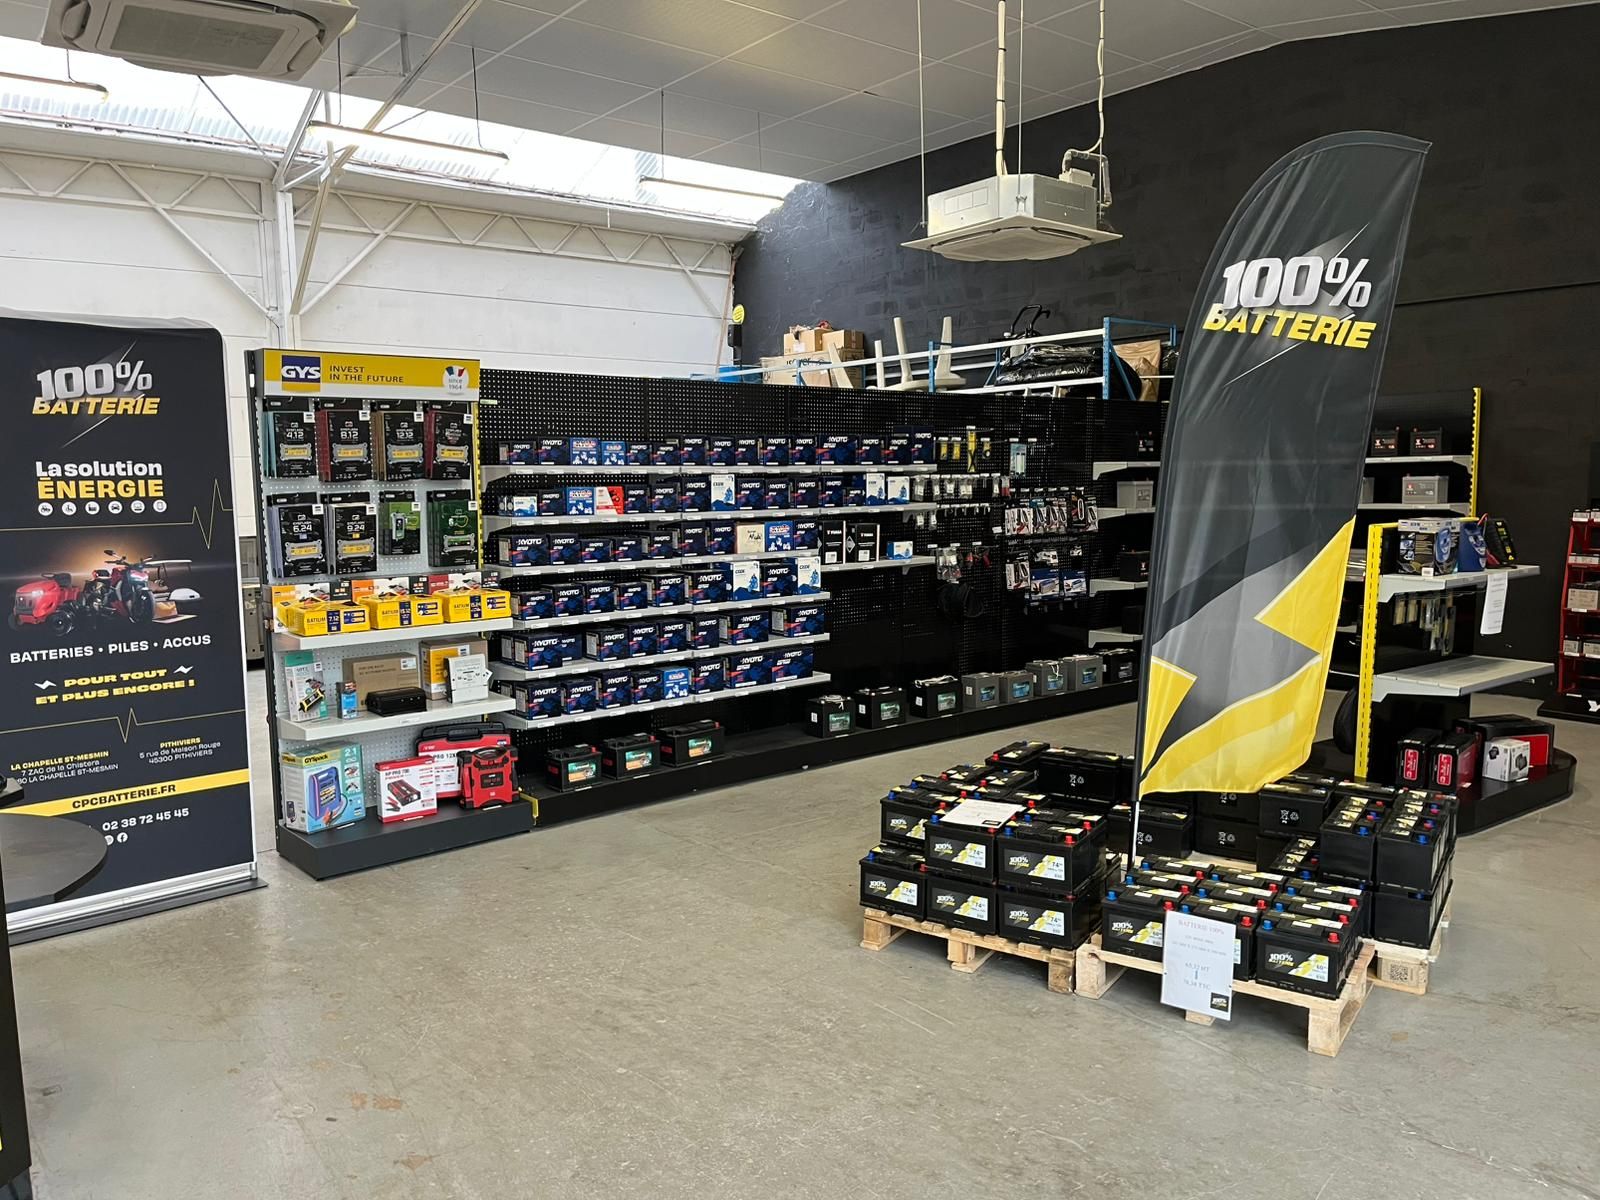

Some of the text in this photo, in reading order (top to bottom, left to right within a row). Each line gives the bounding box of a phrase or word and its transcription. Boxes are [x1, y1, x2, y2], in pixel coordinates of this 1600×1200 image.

[1223, 256, 1372, 310] 100%
[1202, 303, 1376, 349] BATTERIE
[37, 360, 152, 400] 100%
[281, 366, 321, 379] GYS
[32, 396, 160, 415] BATTERIE
[36, 461, 162, 477] La solution
[10, 635, 211, 664] BATTERIES PILES ACCUS
[64, 669, 167, 688] POUR TOUT
[35, 696, 58, 705] ET
[62, 689, 109, 702] PLUS
[113, 681, 184, 696] ENCORE
[160, 737, 201, 749] PITHIVIERS
[22, 758, 63, 769] CHAPELLE
[64, 751, 109, 764] ST-MESMIN
[174, 749, 213, 760] PITHIVIERS
[39, 770, 76, 781] CHAPELLE
[77, 763, 118, 776] ST-MESMIN
[72, 784, 176, 809] CPCBATTERIE.FR
[102, 808, 189, 832] 02 38 72 45 45
